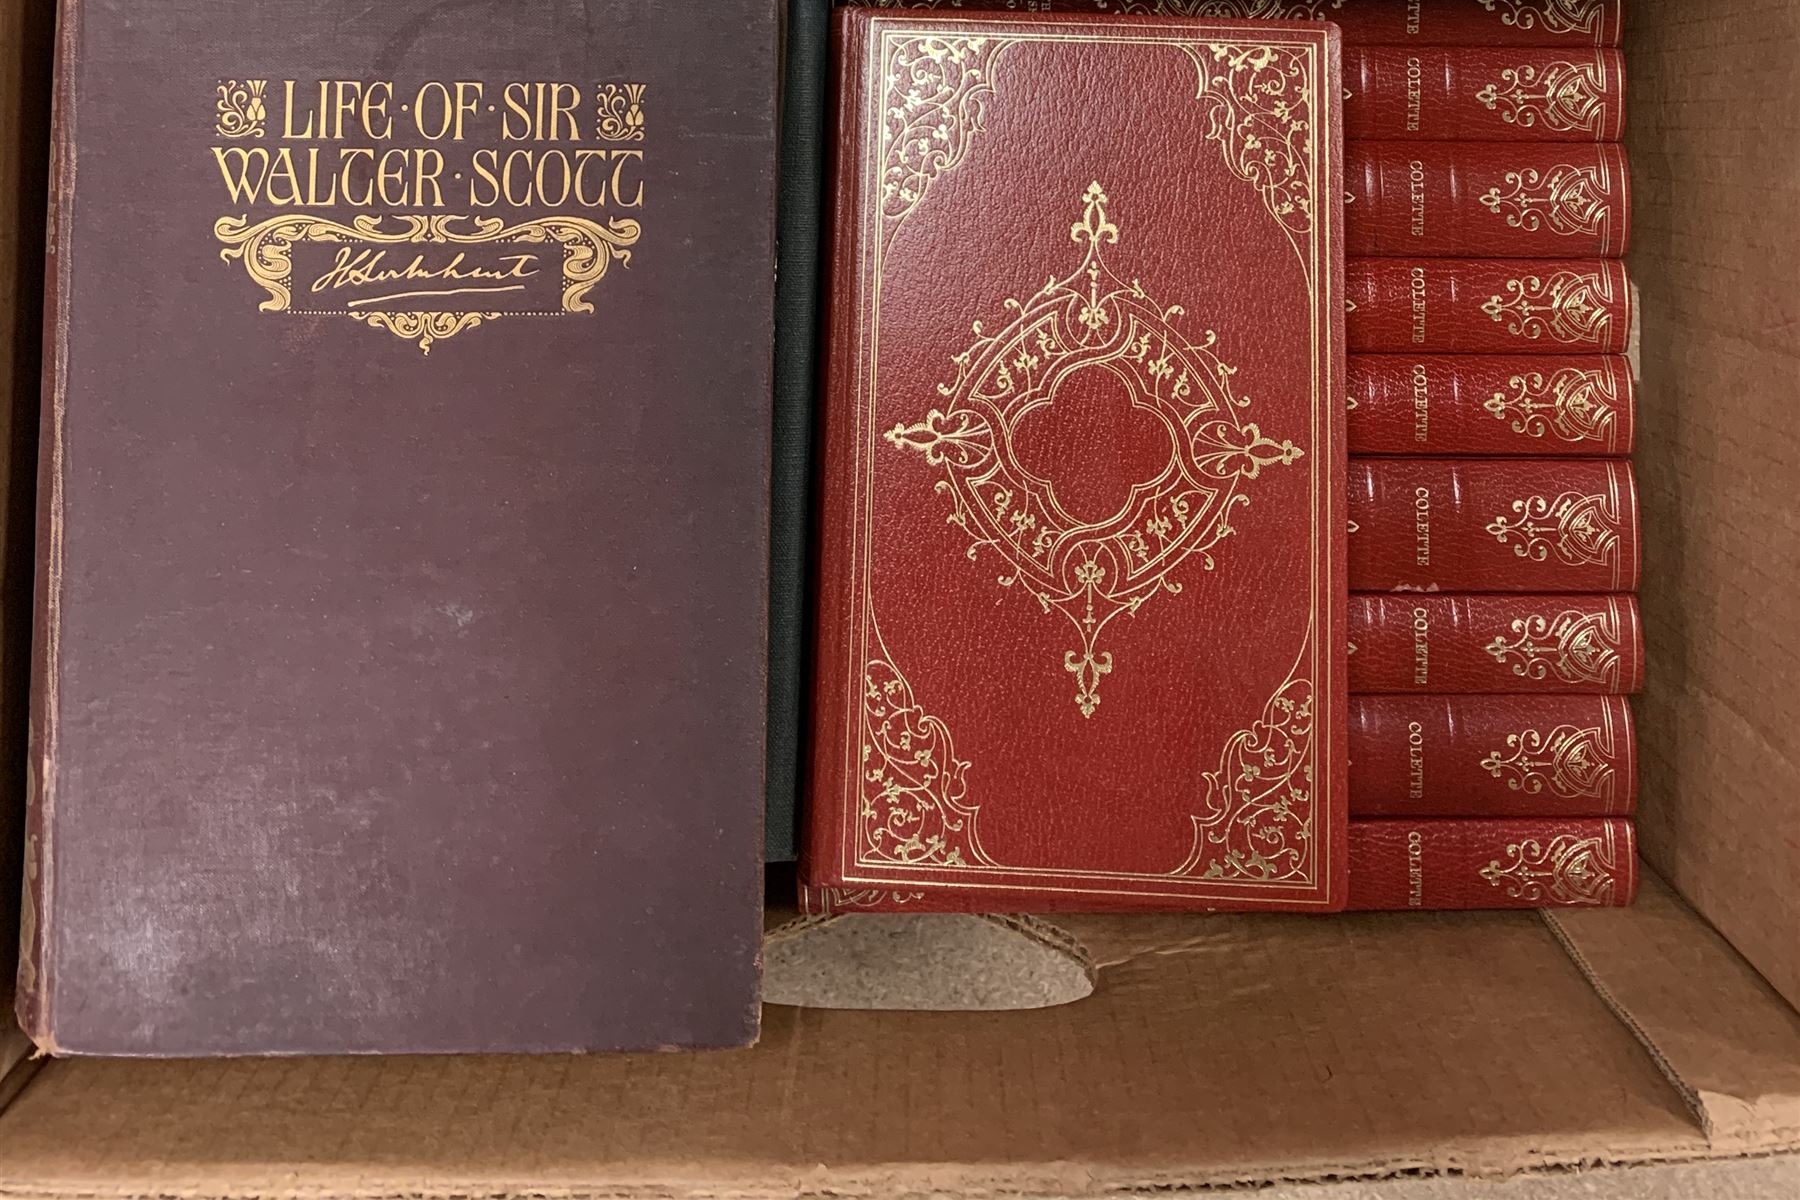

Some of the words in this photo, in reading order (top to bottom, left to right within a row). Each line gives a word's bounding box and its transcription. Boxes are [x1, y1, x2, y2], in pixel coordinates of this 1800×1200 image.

[281, 80, 394, 140] LIFE
[414, 80, 483, 141] OF
[502, 81, 581, 141] SIR
[1406, 57, 1421, 132] COLETTE
[210, 146, 445, 207] WALTER
[470, 148, 645, 208] SCOTT
[1409, 160, 1425, 237] COLETTE
[1410, 267, 1426, 344] COLETTE
[1412, 364, 1429, 442] COLETTE
[1414, 487, 1430, 567] COLETTE
[1412, 607, 1429, 685] COLETTE
[1408, 721, 1424, 799] COLETTE
[1407, 831, 1423, 906] COLETTE
